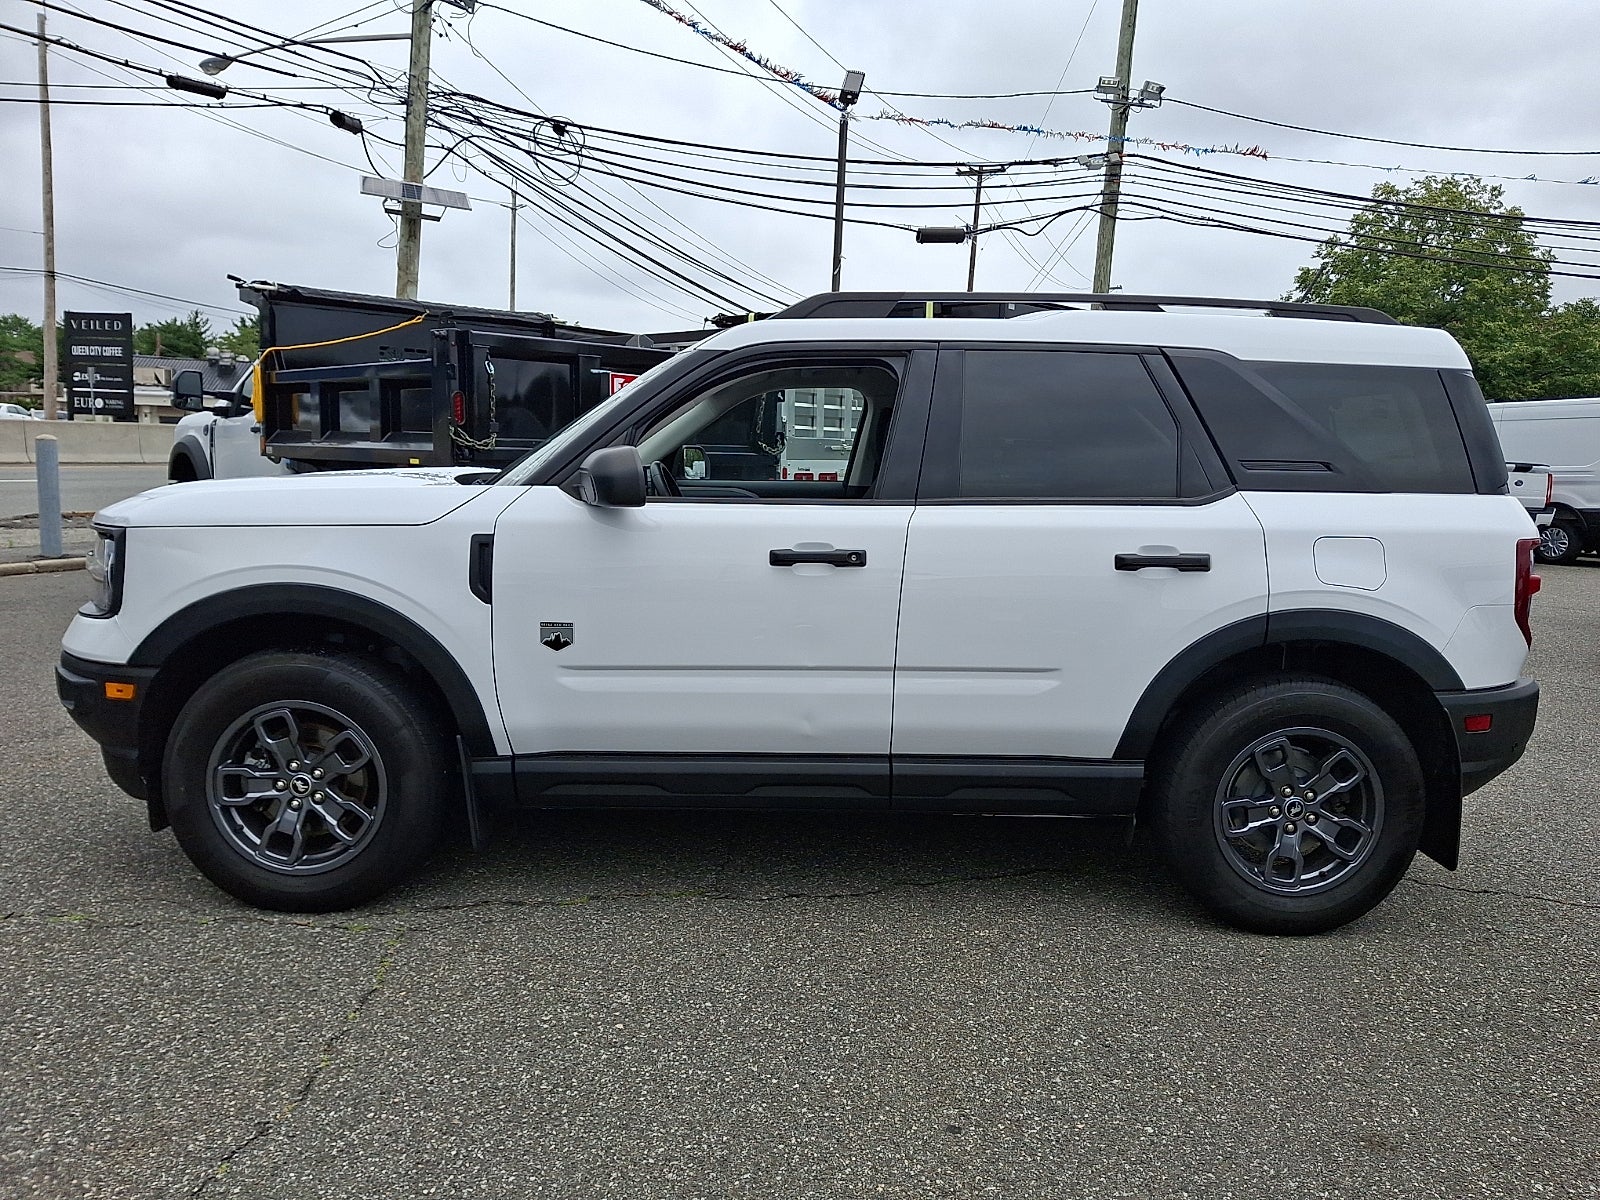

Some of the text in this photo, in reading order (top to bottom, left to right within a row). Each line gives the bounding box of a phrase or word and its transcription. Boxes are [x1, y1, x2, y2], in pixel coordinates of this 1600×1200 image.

[70, 319, 122, 331] VEILED
[71, 345, 123, 357] QUEEN CITY COFFEE
